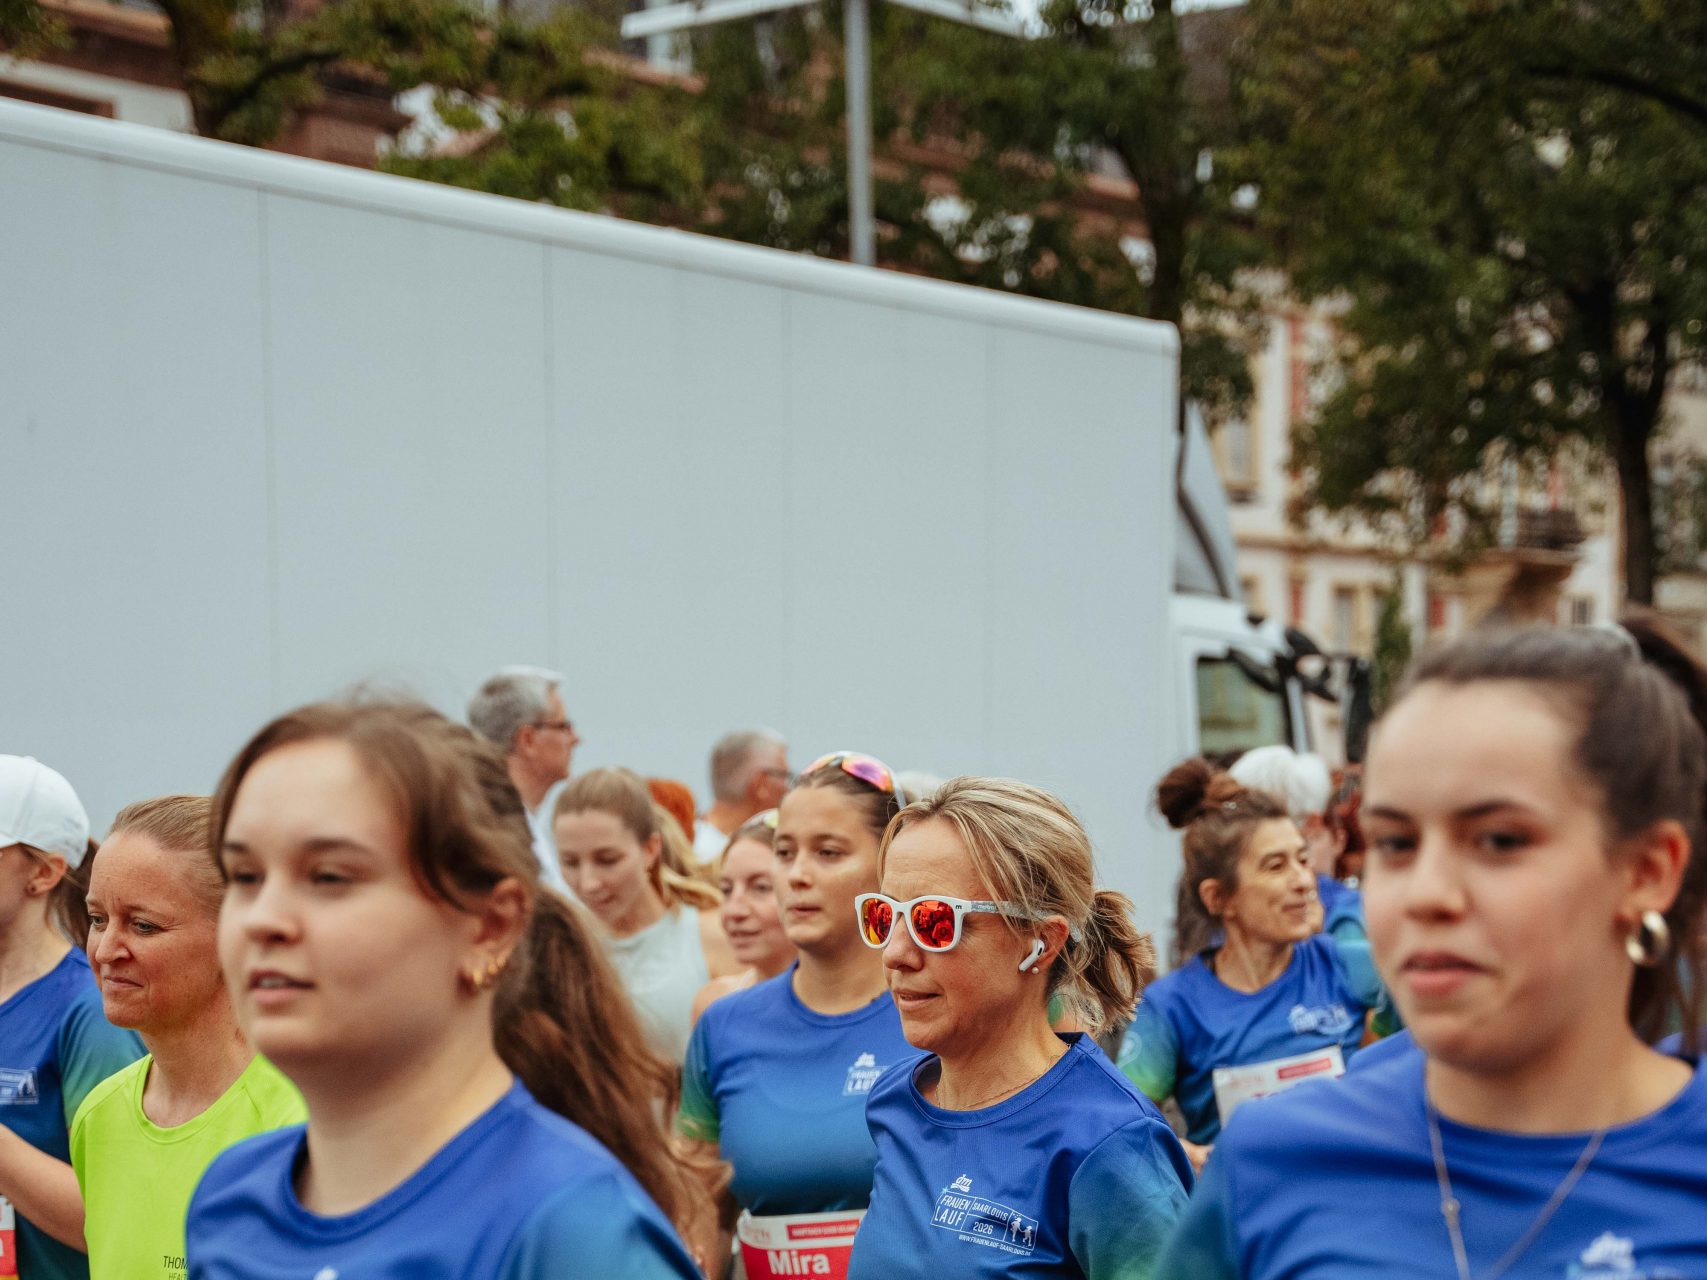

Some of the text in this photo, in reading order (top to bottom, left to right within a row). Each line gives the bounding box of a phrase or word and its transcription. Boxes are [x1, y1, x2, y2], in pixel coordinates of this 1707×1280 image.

[940, 1195, 973, 1211] FRAUEN
[972, 1202, 1009, 1221] SAARLOUIS
[934, 1206, 965, 1226] LAUF
[972, 1221, 994, 1235] 2026
[766, 1249, 831, 1276] Mira
